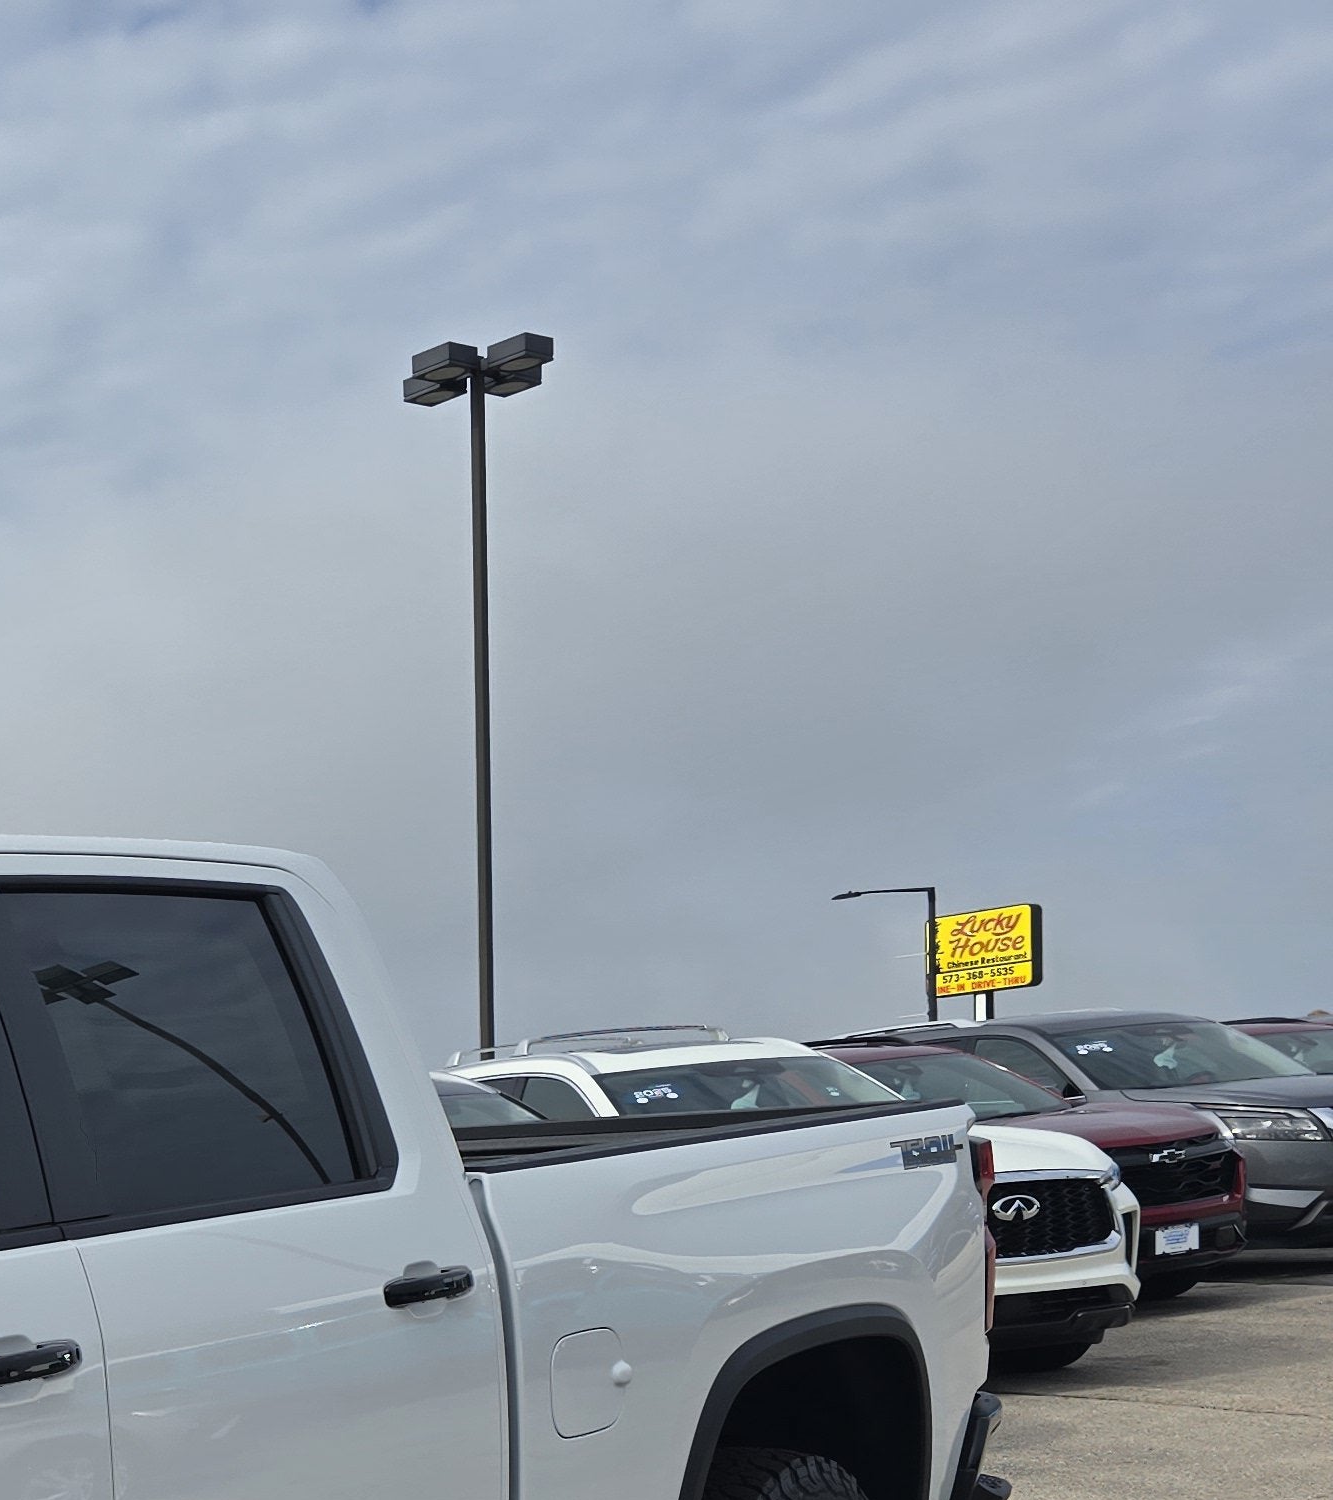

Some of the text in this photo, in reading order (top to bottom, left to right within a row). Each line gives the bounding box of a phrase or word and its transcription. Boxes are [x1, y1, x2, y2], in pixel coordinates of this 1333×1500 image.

[950, 912, 1023, 937] Lucky
[949, 935, 1025, 959] House
[946, 951, 1028, 970] Chinese Restaurant
[937, 975, 1026, 995] INE-IN DRIVE-THRU
